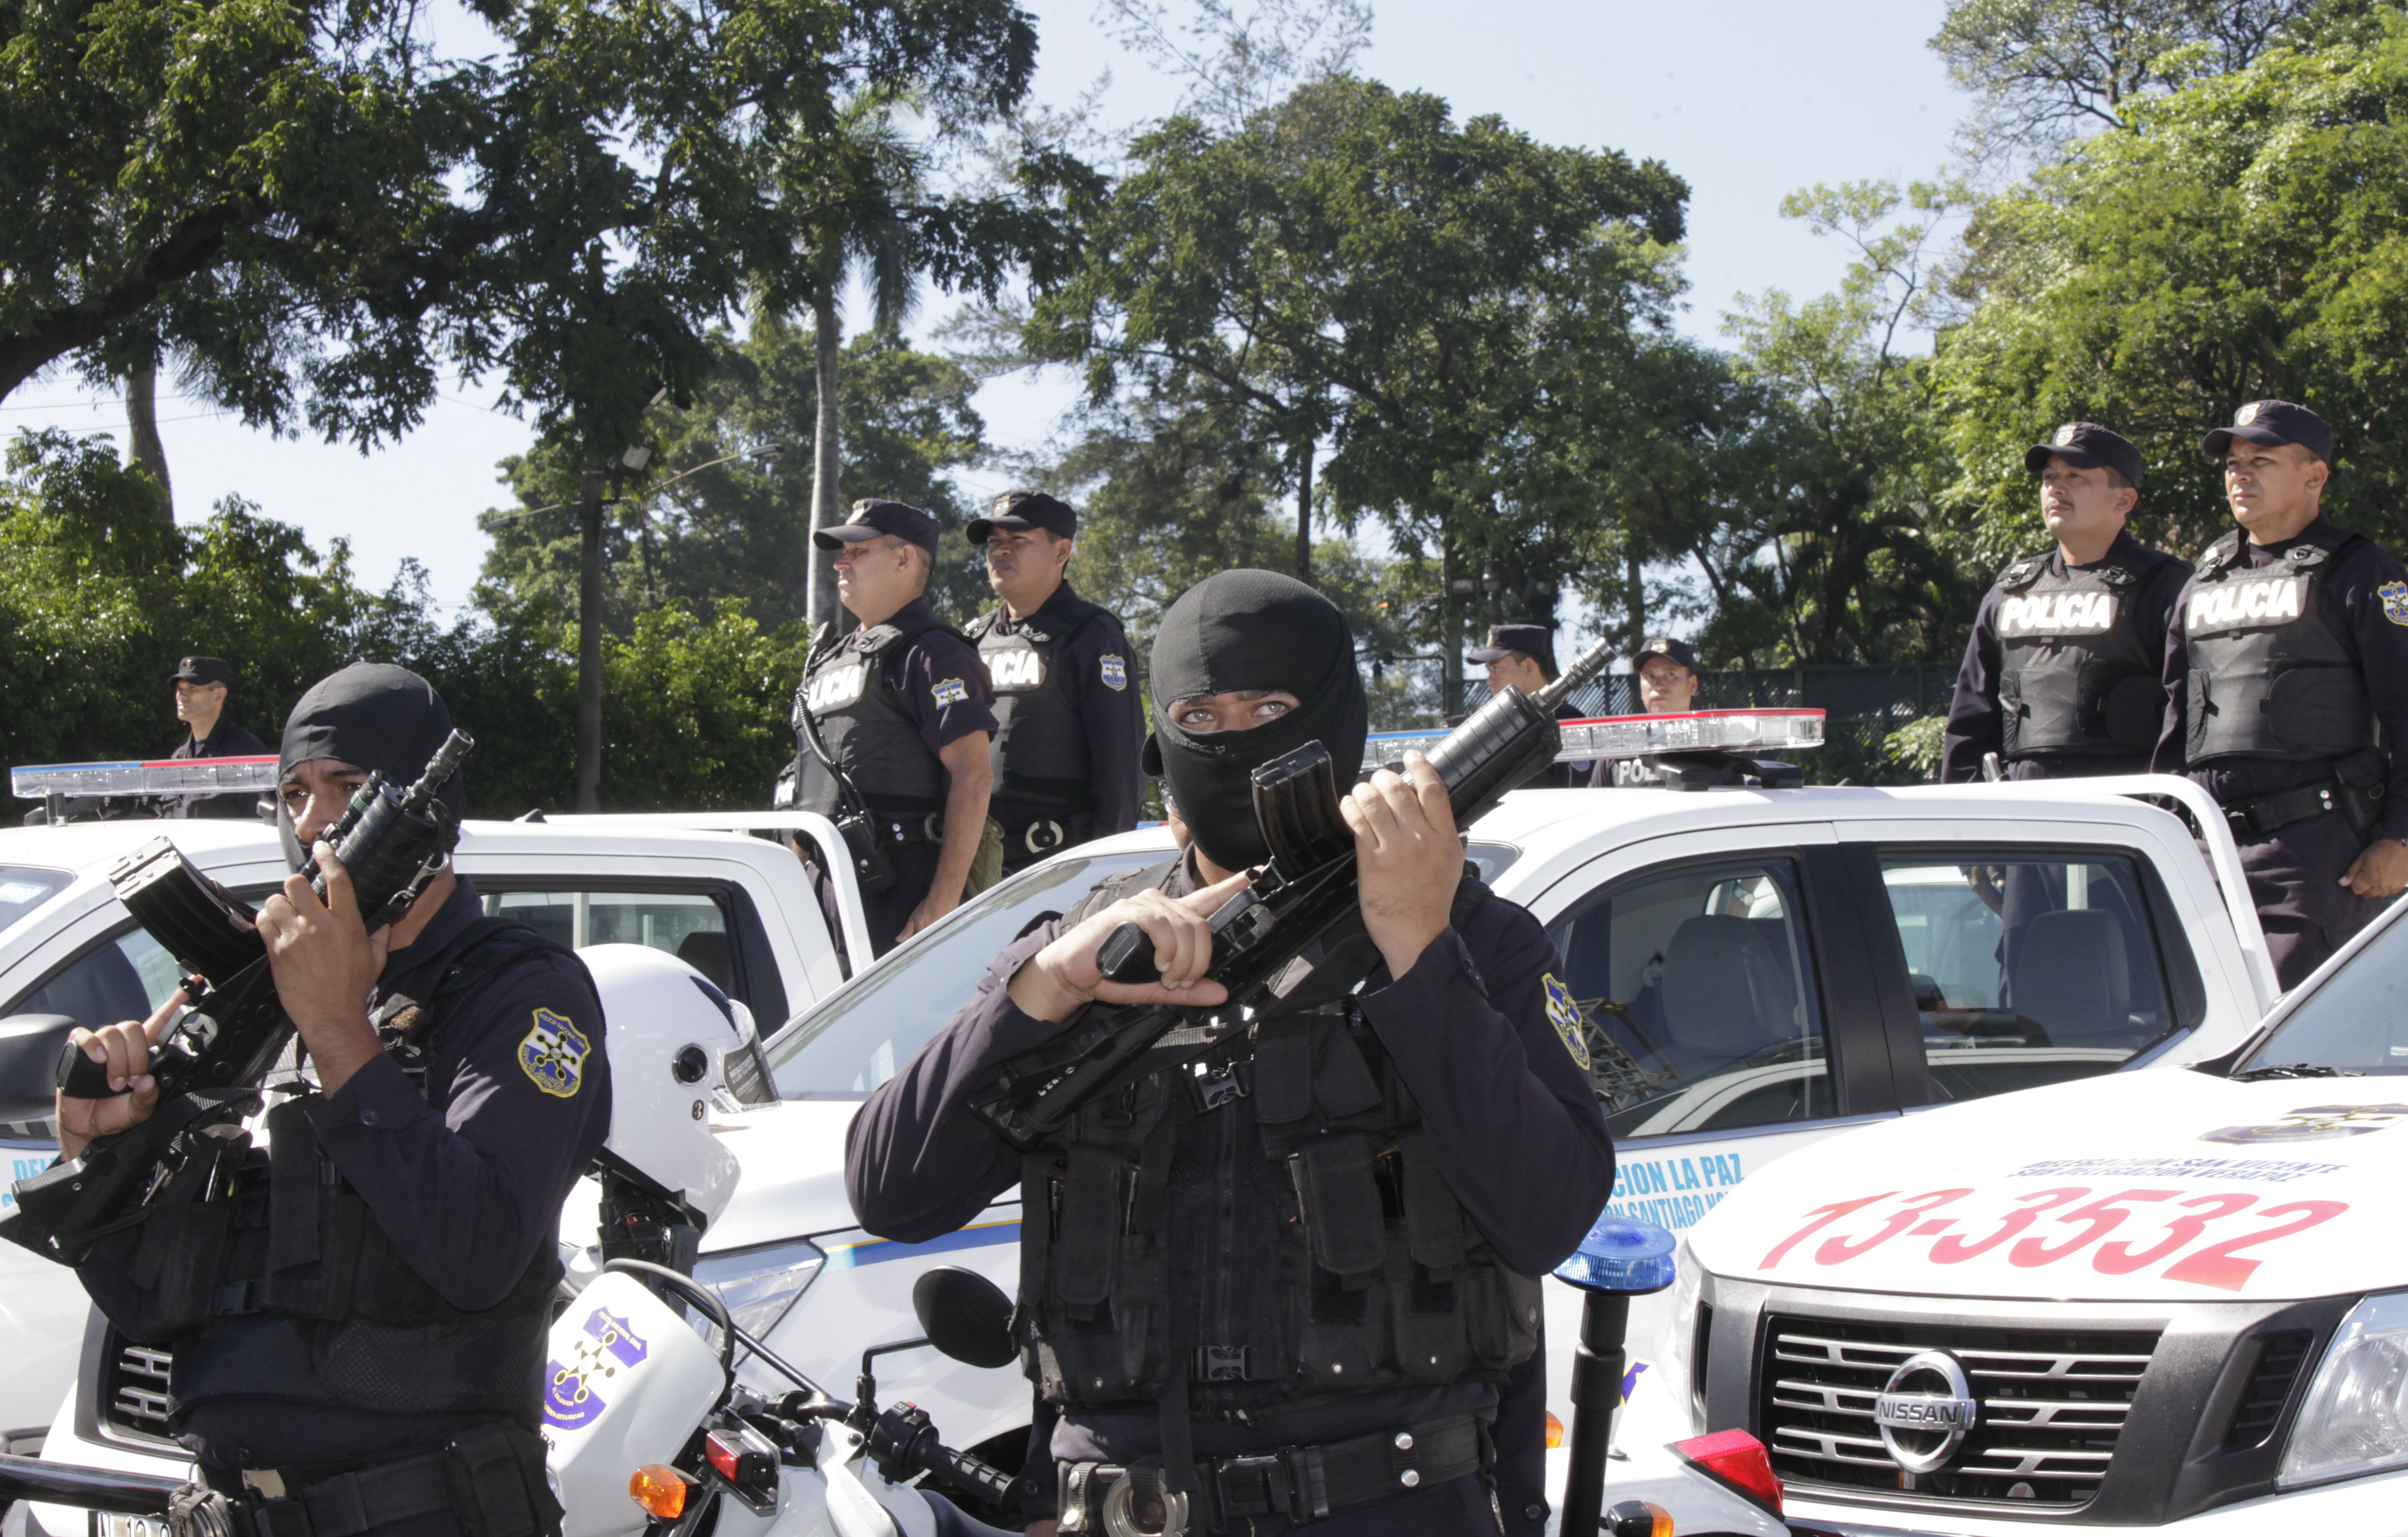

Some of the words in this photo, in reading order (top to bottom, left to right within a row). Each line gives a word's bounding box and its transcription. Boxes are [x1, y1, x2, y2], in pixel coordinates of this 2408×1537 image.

[982, 650, 1039, 685] ICÍA
[1619, 759, 1660, 785] POL
[729, 1053, 754, 1079] RESISTENTE
[1667, 1158, 1701, 1191] LA
[1699, 1153, 1746, 1187] PAZ
[2173, 1158, 2239, 1168] SAN
[2229, 1159, 2350, 1173] VICENTE
[2190, 1169, 2308, 1182] VERAPAZ
[1627, 1195, 1706, 1230] SANTIAGO
[1757, 1187, 2350, 1293] 13-3532
[612, 1322, 630, 1341] NACIONAL
[629, 1337, 642, 1351] CIVIL
[554, 1392, 574, 1407] SALVADOR
[1878, 1401, 1958, 1423] NISSAN
